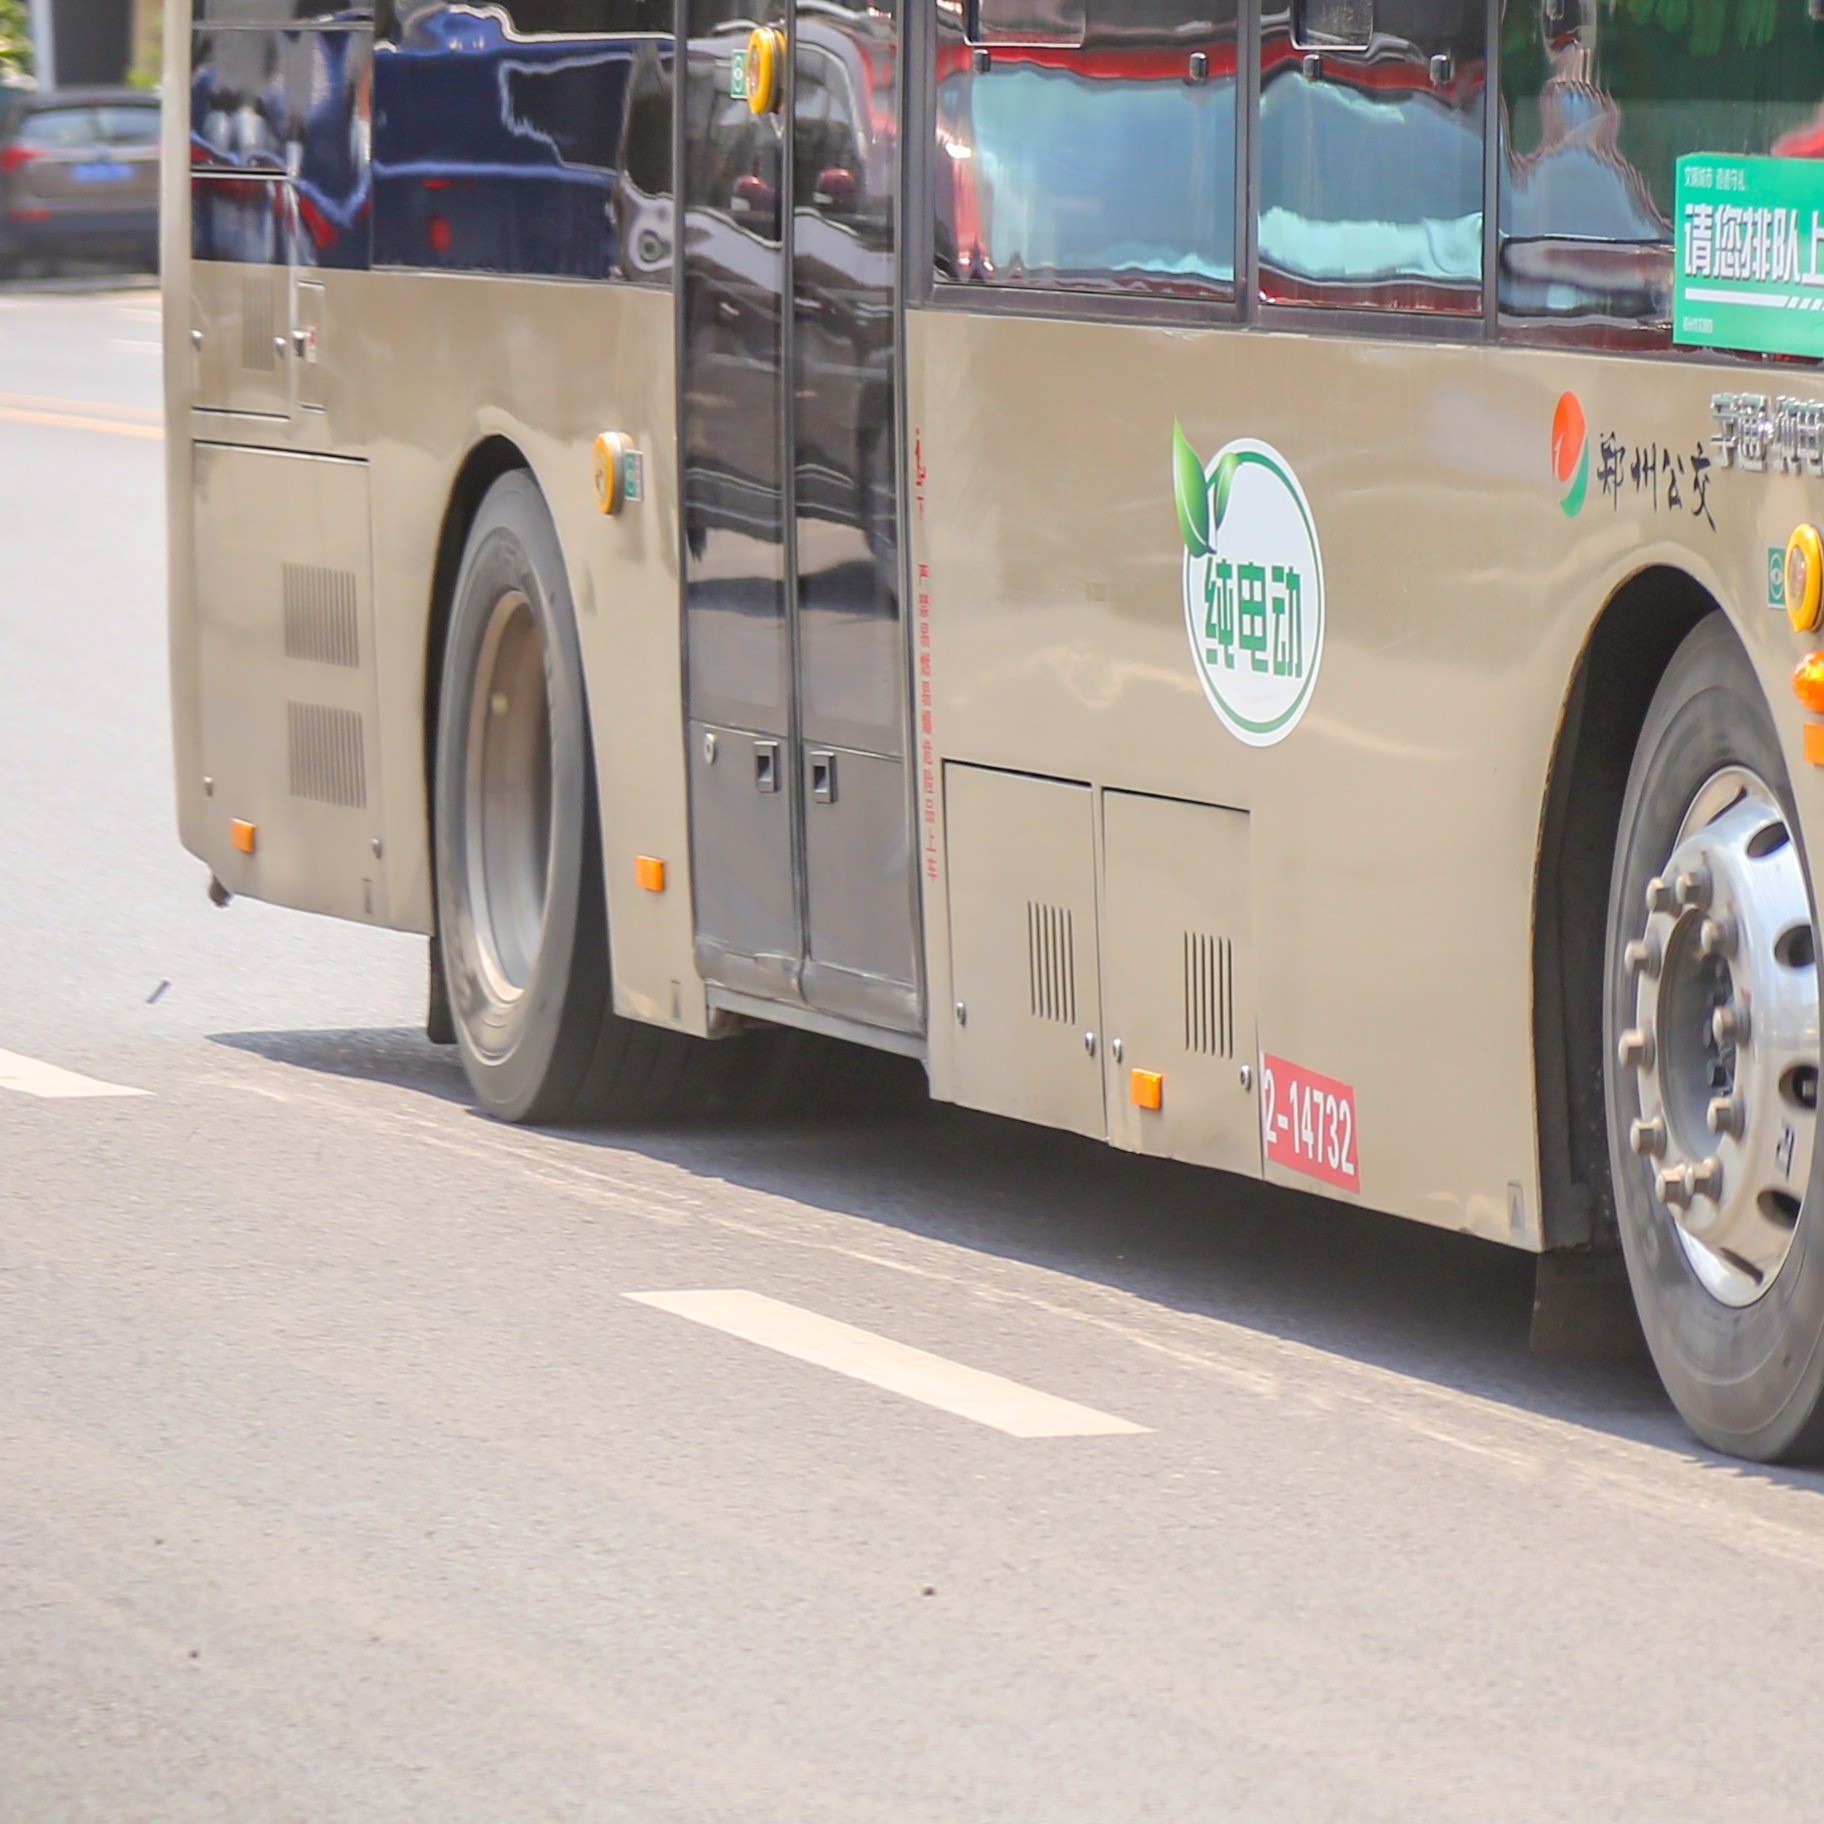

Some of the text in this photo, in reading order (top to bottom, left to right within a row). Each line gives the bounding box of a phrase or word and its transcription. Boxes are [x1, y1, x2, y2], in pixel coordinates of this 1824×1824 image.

[1596, 431, 1717, 534] 郑州公交
[1204, 556, 1301, 678] 纯电动
[1263, 1067, 1355, 1176] 2-14732
